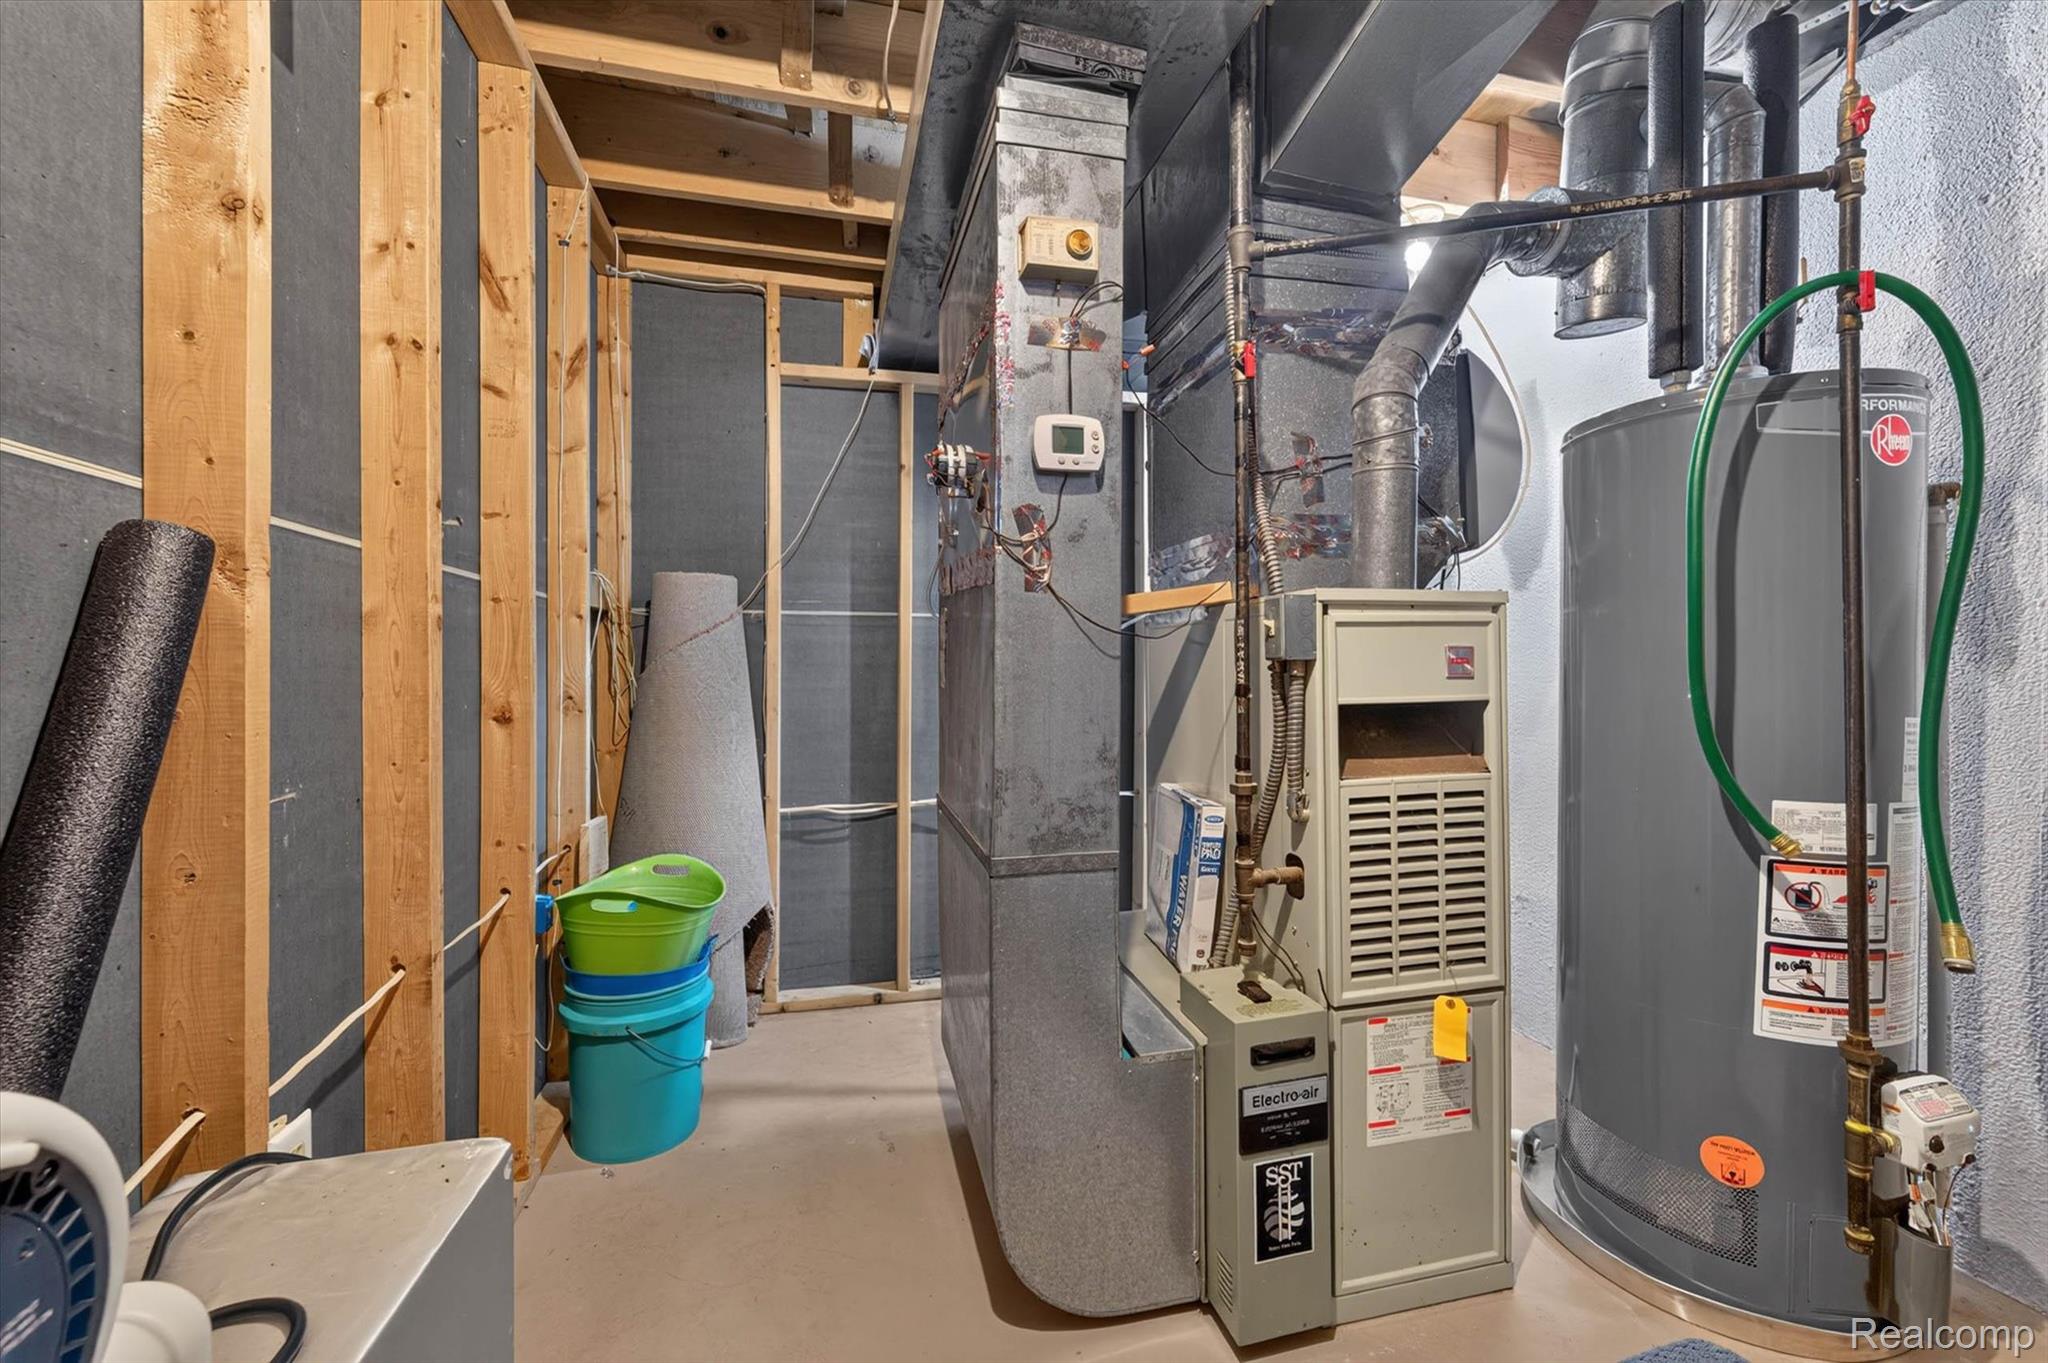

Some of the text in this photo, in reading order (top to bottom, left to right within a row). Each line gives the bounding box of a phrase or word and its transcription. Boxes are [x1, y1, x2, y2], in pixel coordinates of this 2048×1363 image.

[1876, 416, 1912, 457] Rheem
[1172, 874, 1188, 927] WATER
[1265, 1160, 1303, 1188] SST
